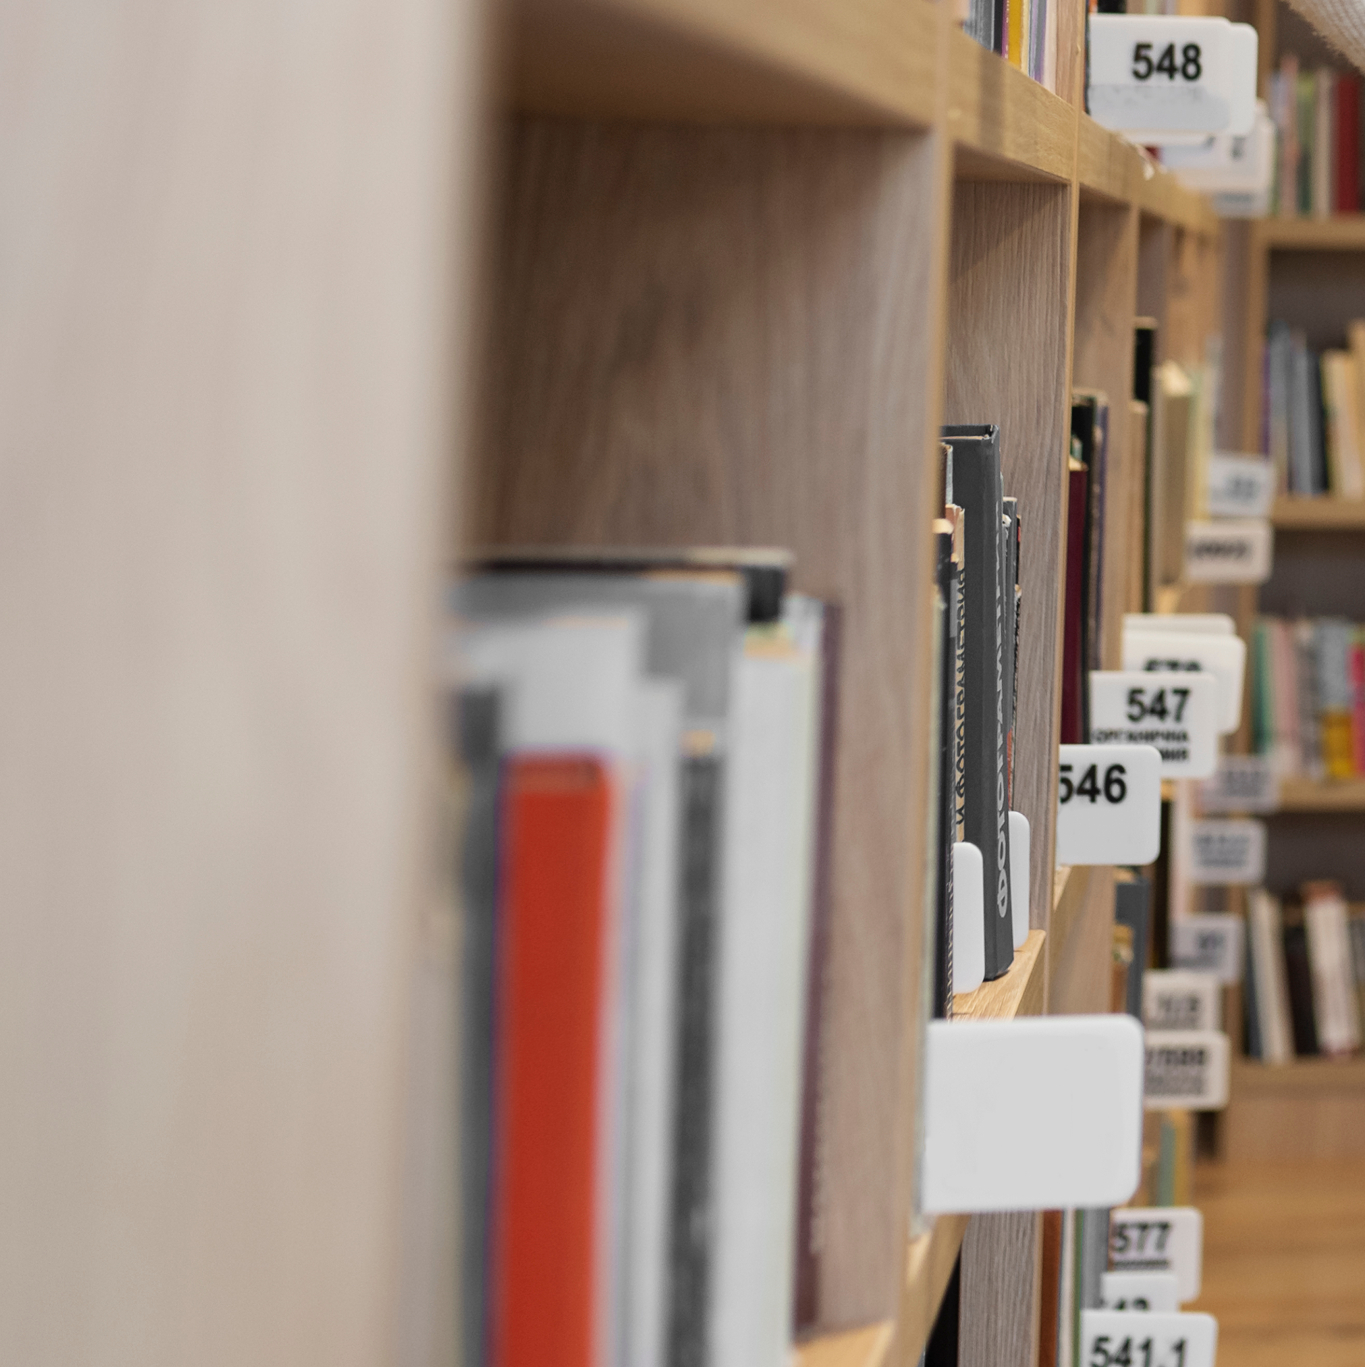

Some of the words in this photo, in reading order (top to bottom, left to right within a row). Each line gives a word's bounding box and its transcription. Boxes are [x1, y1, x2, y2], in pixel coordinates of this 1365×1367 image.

[1131, 42, 1202, 81] 548
[1126, 687, 1191, 723] 547
[1059, 763, 1127, 804] 546
[1112, 1221, 1171, 1253] 577
[1092, 1336, 1186, 1367] 5411
